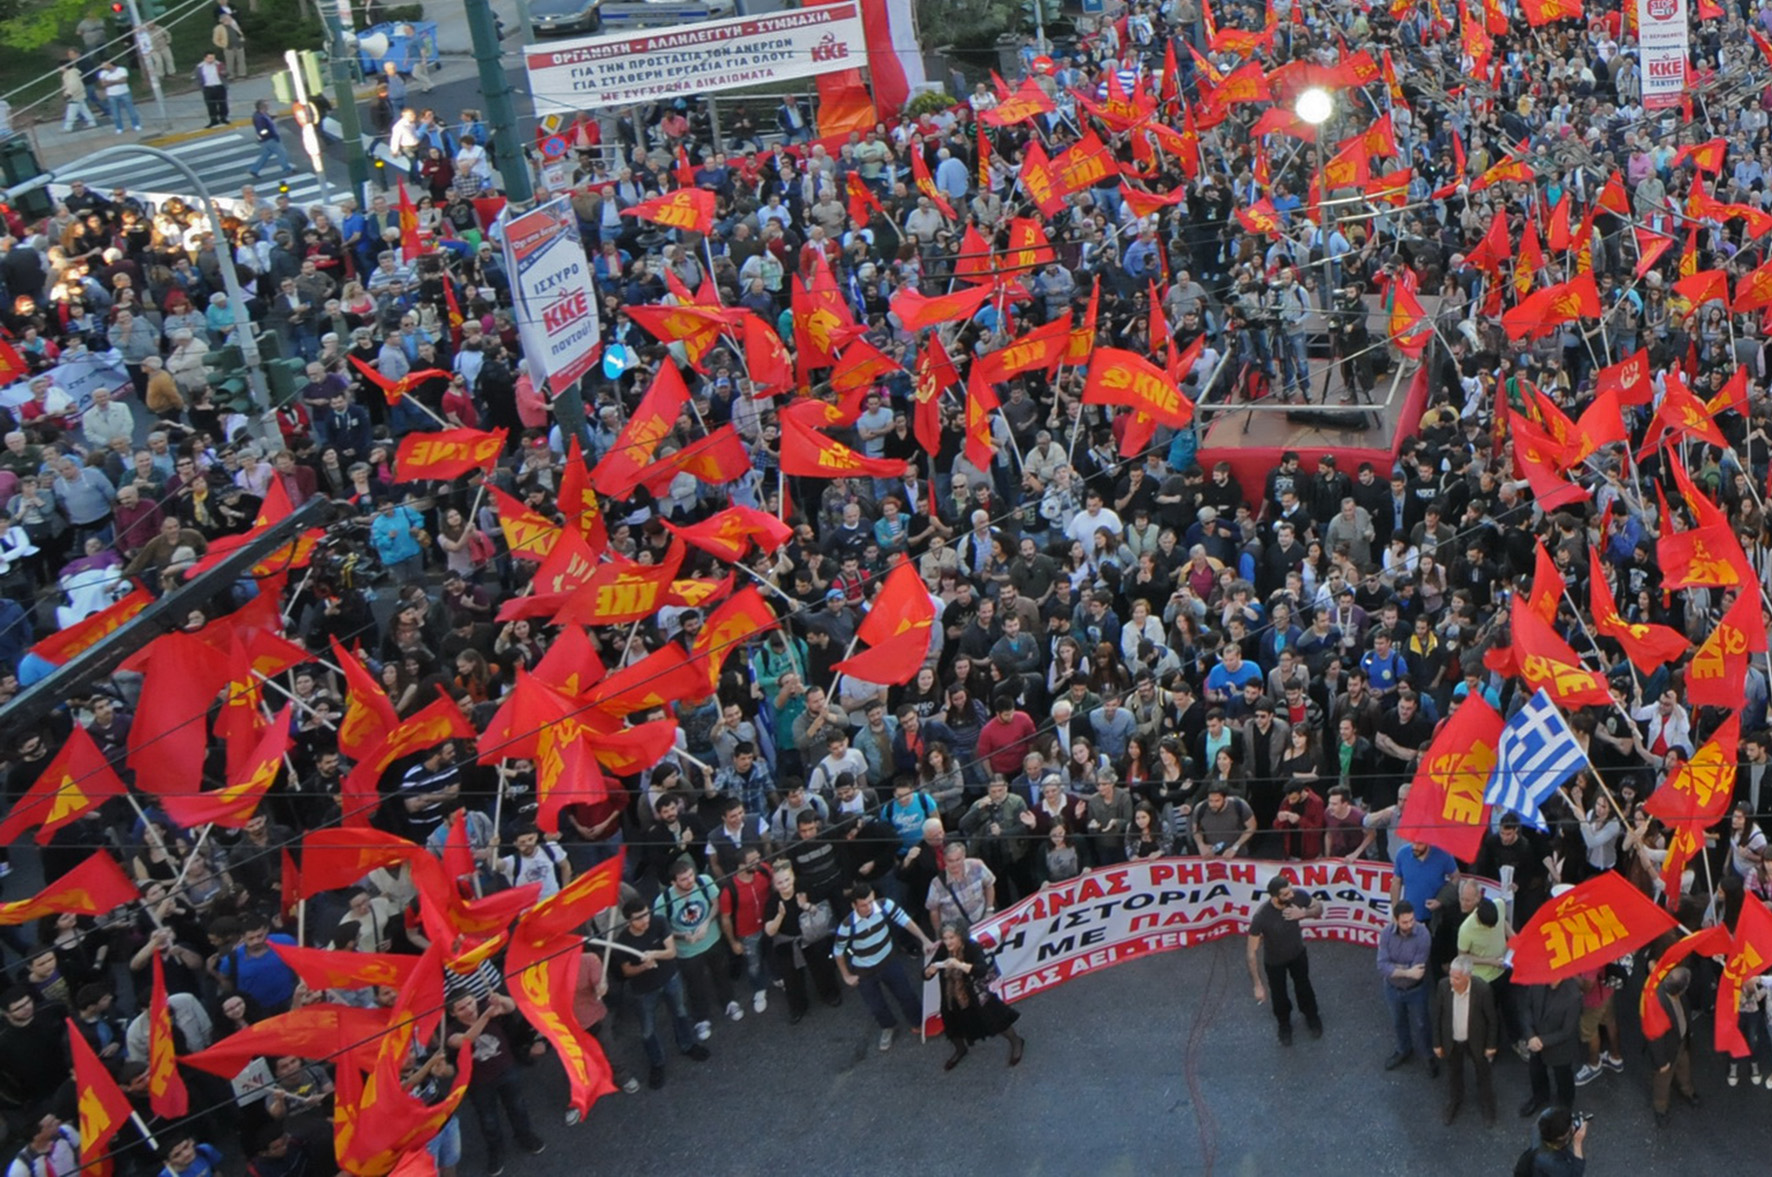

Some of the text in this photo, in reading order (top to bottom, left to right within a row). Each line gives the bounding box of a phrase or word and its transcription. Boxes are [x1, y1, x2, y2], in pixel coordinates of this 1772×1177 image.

[1651, 0, 1675, 10] STOP
[552, 41, 631, 65] ΟΡΓΑΝΩΣΗ
[647, 25, 743, 51] ΑΛΛΗΛΕΓΓΥΗ
[757, 11, 831, 34] ΣΥΜΜΑΧΙΑ
[571, 38, 793, 78] ΓΙΑ ΤΗΝ ΠΡΟΣΤΑΣΙΑ ΤΩΝ ΑΝΕΡΓΩΝ
[811, 41, 849, 63] ΚΚΕ
[573, 50, 794, 90] ΓΙΑ ΣΤΑΘΕΡΗ ΕΡΓΑΣΙΑ ΓΙΑ ΟΛΟΥΣ
[600, 88, 619, 101] ΜΕ
[696, 68, 774, 87] ΔΙΚΑΙΩΜΑΤΑ
[1649, 61, 1682, 76] ΚΚΕ
[534, 263, 579, 294] ΙΣΧΥΡΟ
[542, 292, 588, 333] ΚΚΕ
[551, 322, 593, 356] παντού!
[1133, 370, 1181, 414] ΚΝΕ
[1150, 862, 1256, 887] ΡΗΞΗ
[1048, 883, 1232, 934] ΙΣΤΟΡΙΑ
[1037, 926, 1107, 963] ΜΕ
[1129, 901, 1250, 933] ΠΑΛΗ
[1070, 947, 1117, 976] ΑΕΙ
[1143, 930, 1189, 951] ΤΕΙ
[1196, 924, 1231, 942] ΤΗΣ
